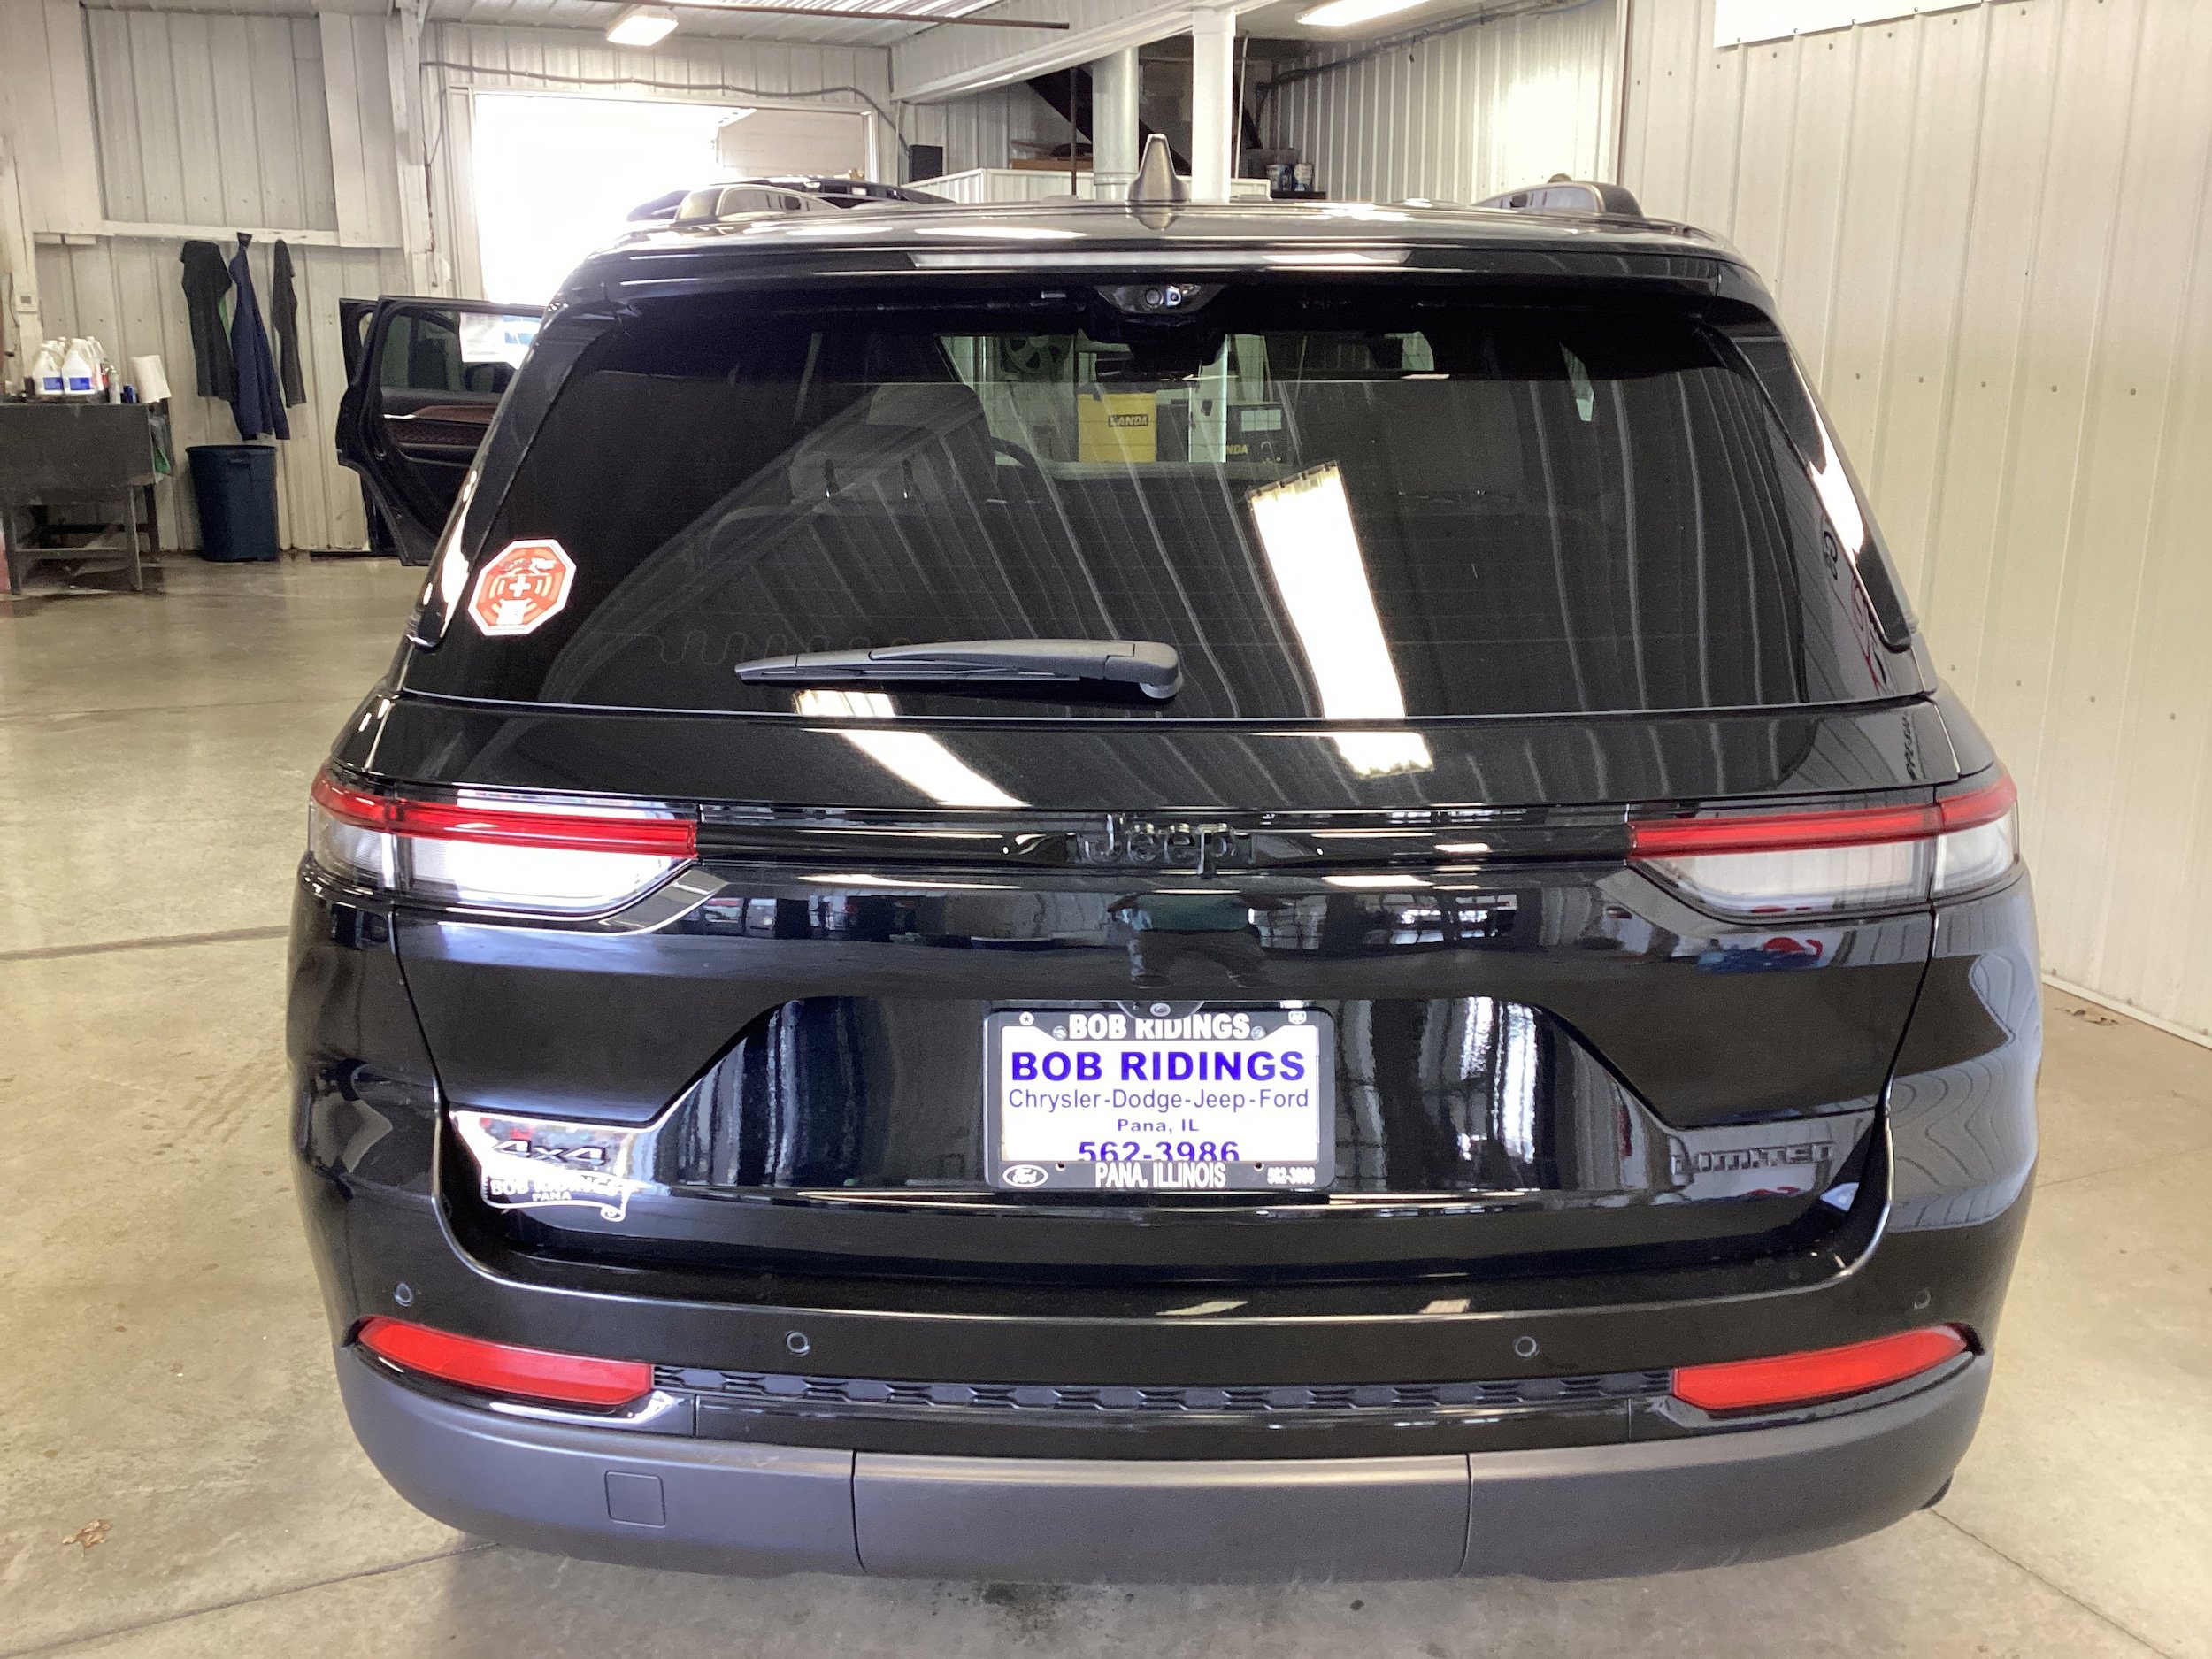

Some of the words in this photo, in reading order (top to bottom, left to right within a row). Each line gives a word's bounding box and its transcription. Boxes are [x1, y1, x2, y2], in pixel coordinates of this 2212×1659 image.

[1109, 414, 1148, 426] LANDA
[1081, 813, 1239, 876] Jeep
[1069, 1013, 1127, 1040] BOB
[1135, 1013, 1251, 1040] RIDINGS
[1011, 1051, 1103, 1081] BOB
[1121, 1051, 1305, 1081] RIDINGS
[1117, 1118, 1172, 1133] Pana,
[1181, 1118, 1199, 1132] IL
[492, 1139, 608, 1165] 4x4
[1078, 1141, 1240, 1161] 562-3986
[1153, 1162, 1226, 1187] ILLINOIS
[490, 1179, 529, 1194] BOB
[532, 1191, 572, 1202] PANA
